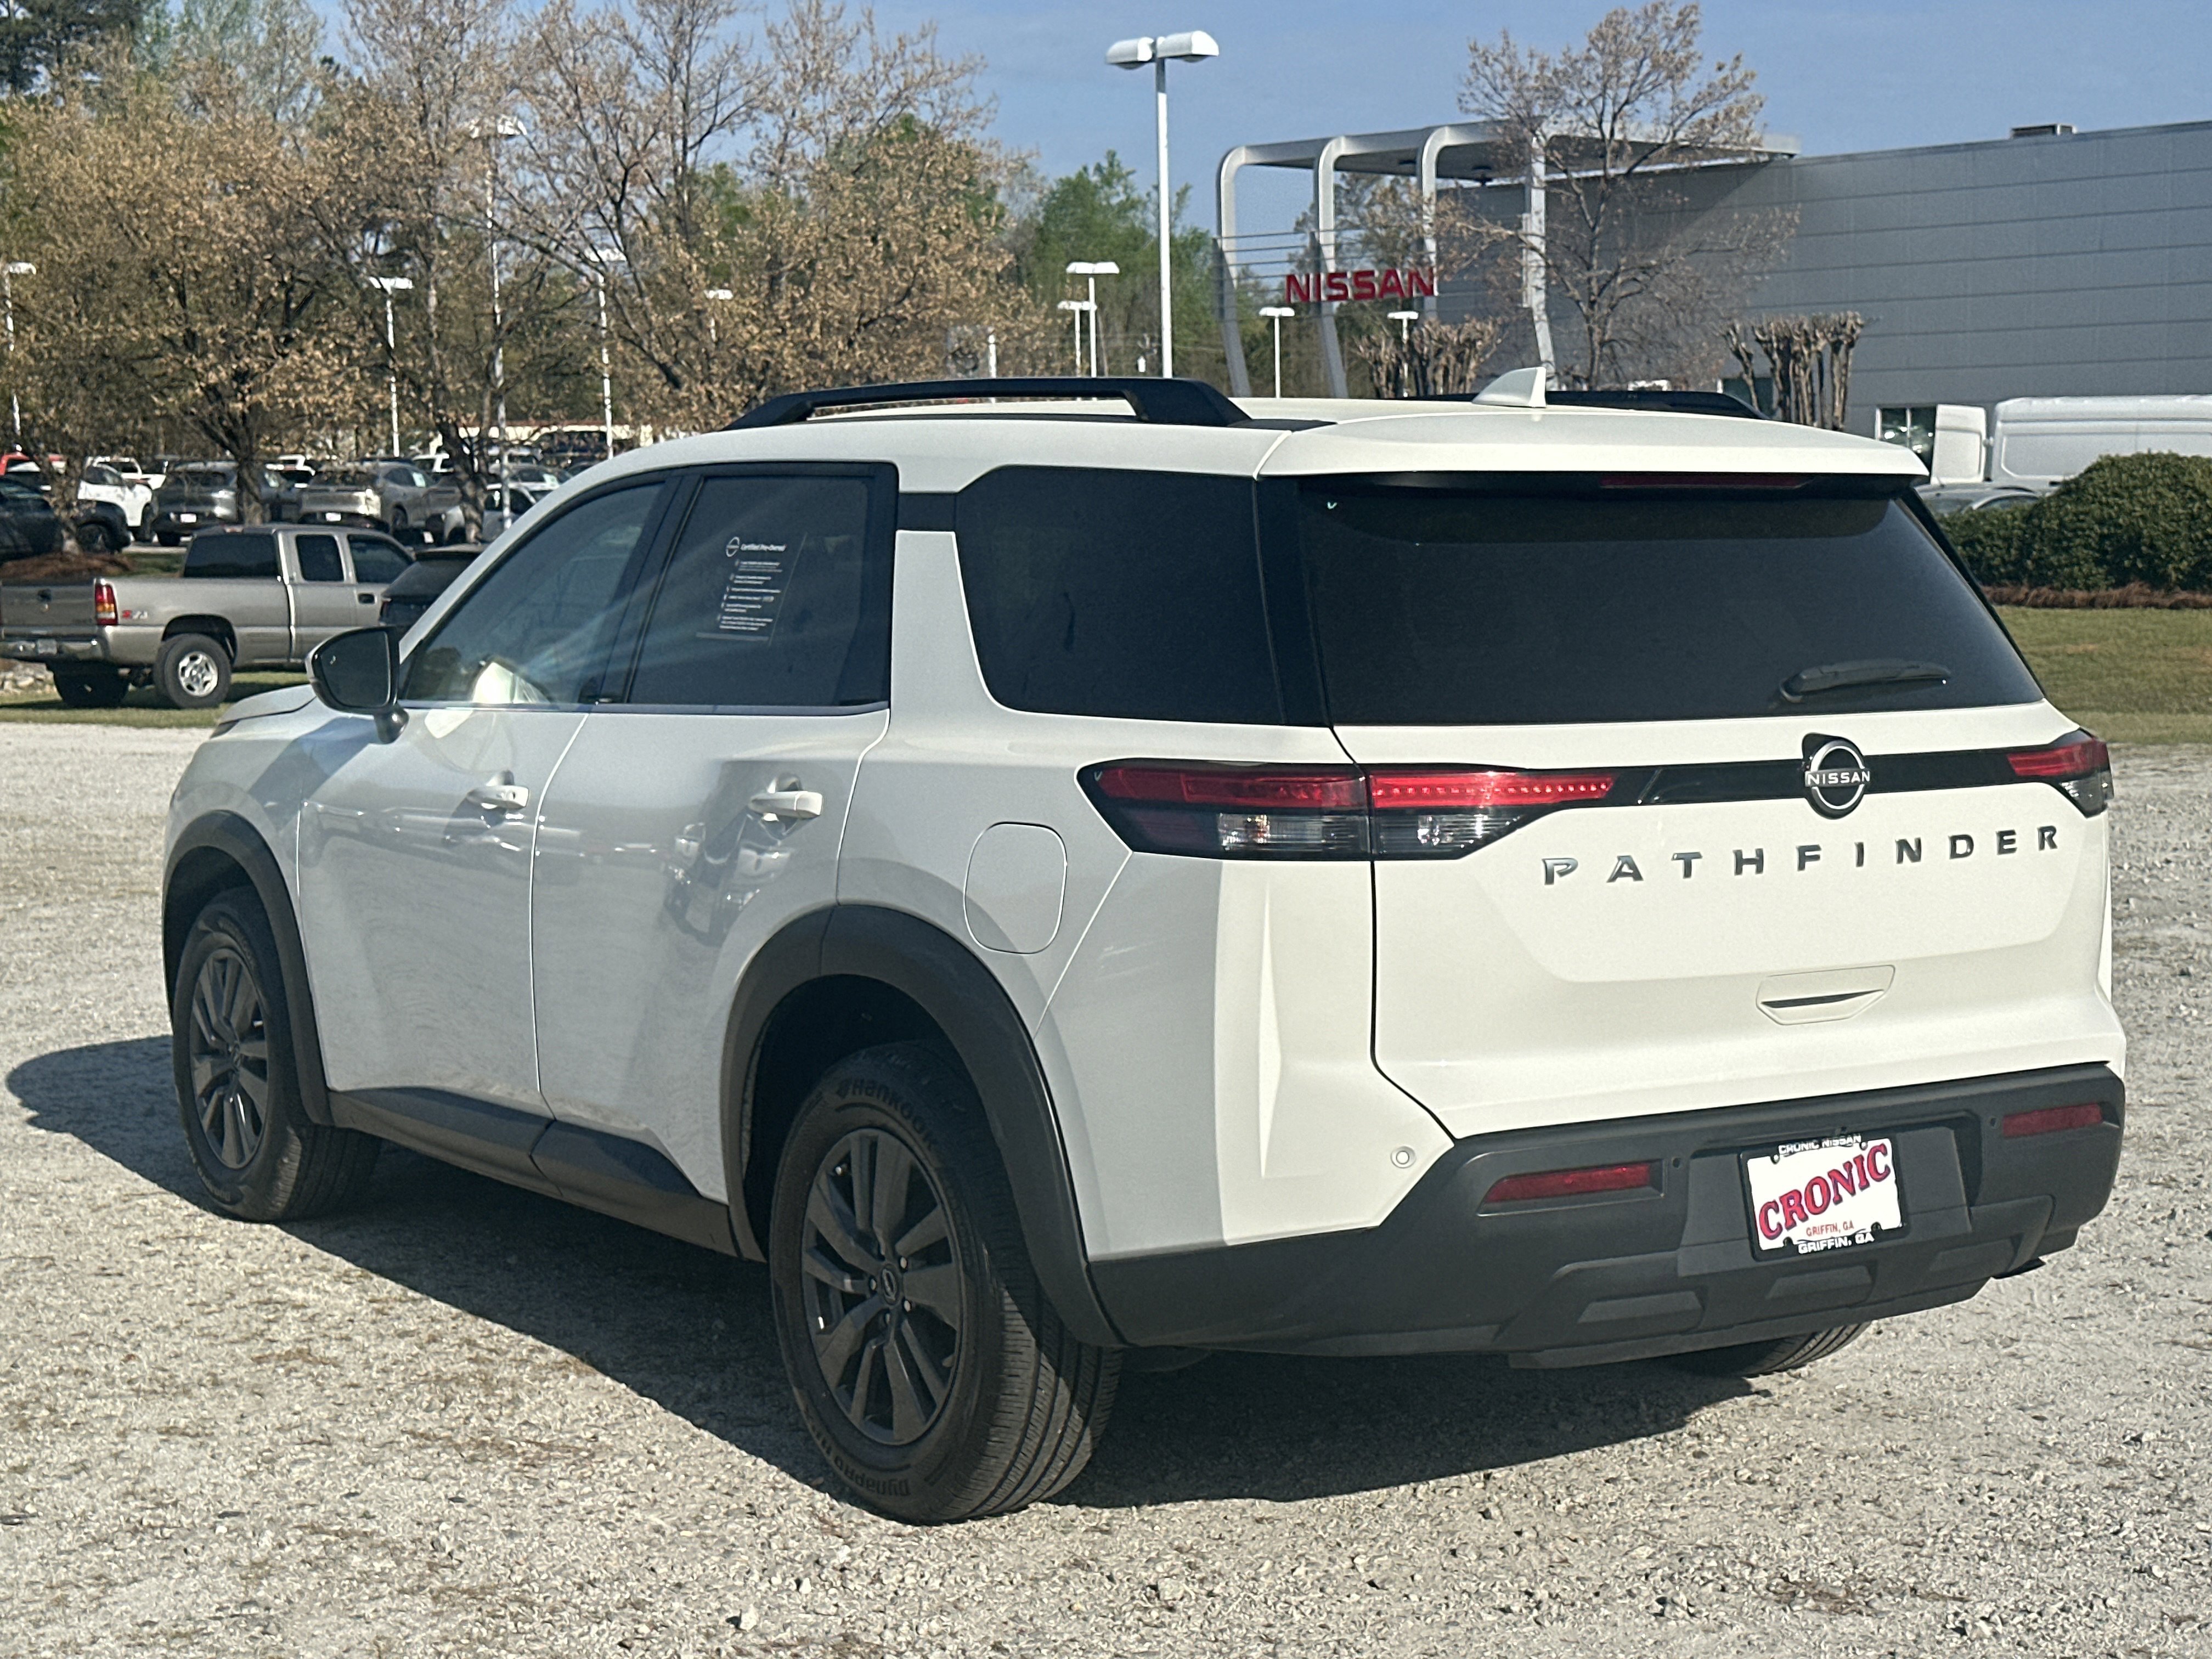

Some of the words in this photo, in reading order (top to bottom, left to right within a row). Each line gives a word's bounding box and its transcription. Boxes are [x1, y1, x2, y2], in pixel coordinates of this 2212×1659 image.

[1285, 268, 1435, 302] NISSAN
[1807, 771, 1870, 785] NISSAN
[1541, 825, 2058, 885] PATHFINDER
[1759, 1143, 1891, 1240] CRONIC
[1805, 1224, 1841, 1237] GRIFFIN,
[1842, 1220, 1854, 1231] GA
[1855, 1232, 1875, 1244] GA
